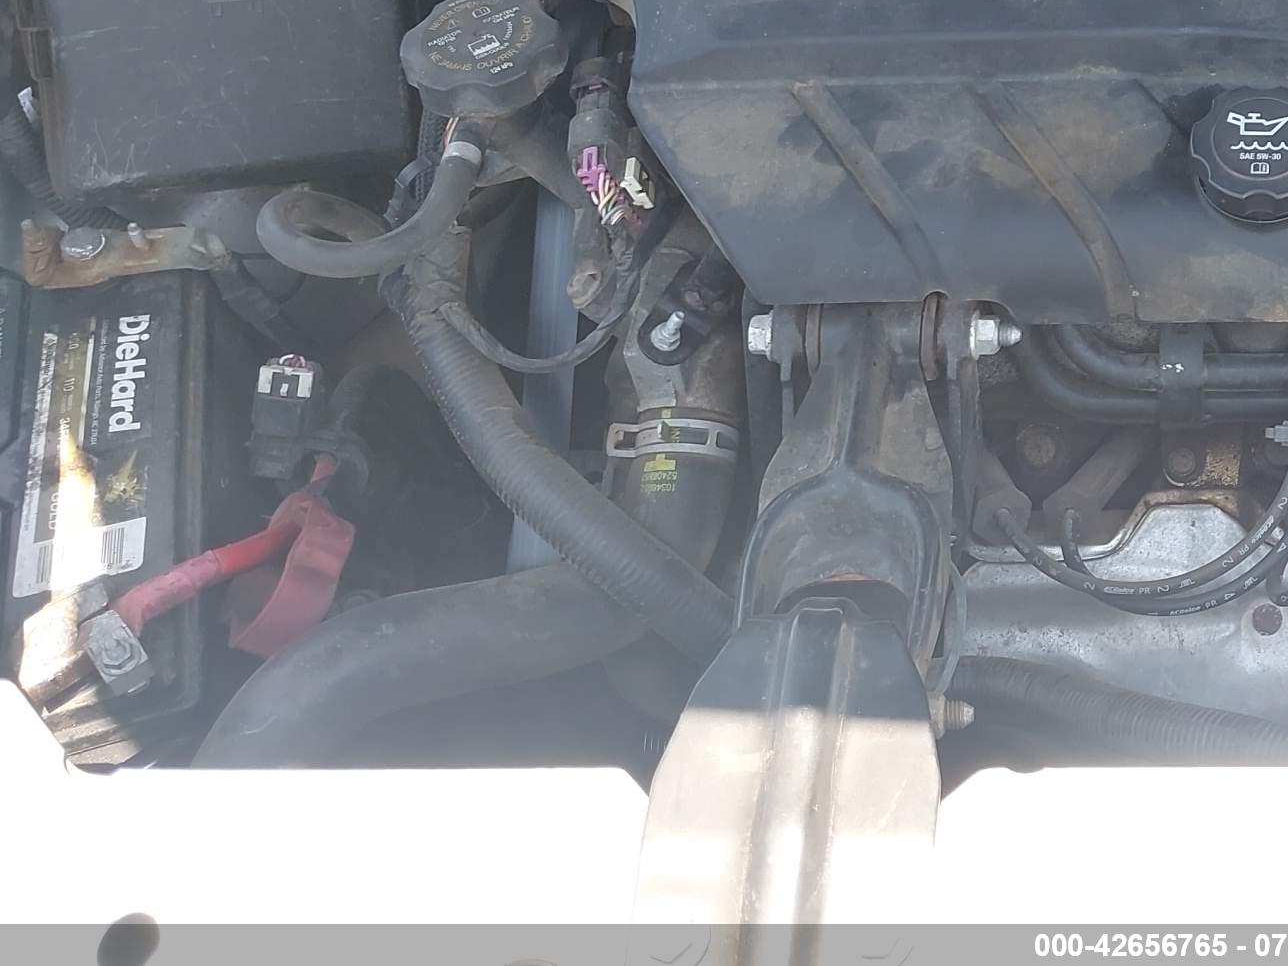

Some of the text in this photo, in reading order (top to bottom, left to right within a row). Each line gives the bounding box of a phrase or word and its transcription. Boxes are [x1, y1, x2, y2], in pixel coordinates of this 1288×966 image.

[1239, 152, 1282, 160] SAE 5W-30
[108, 314, 151, 433] DieHard
[1277, 496, 1288, 511] 2
[1138, 587, 1151, 595] PR
[1156, 583, 1170, 594] 2
[1204, 598, 1219, 610] PR
